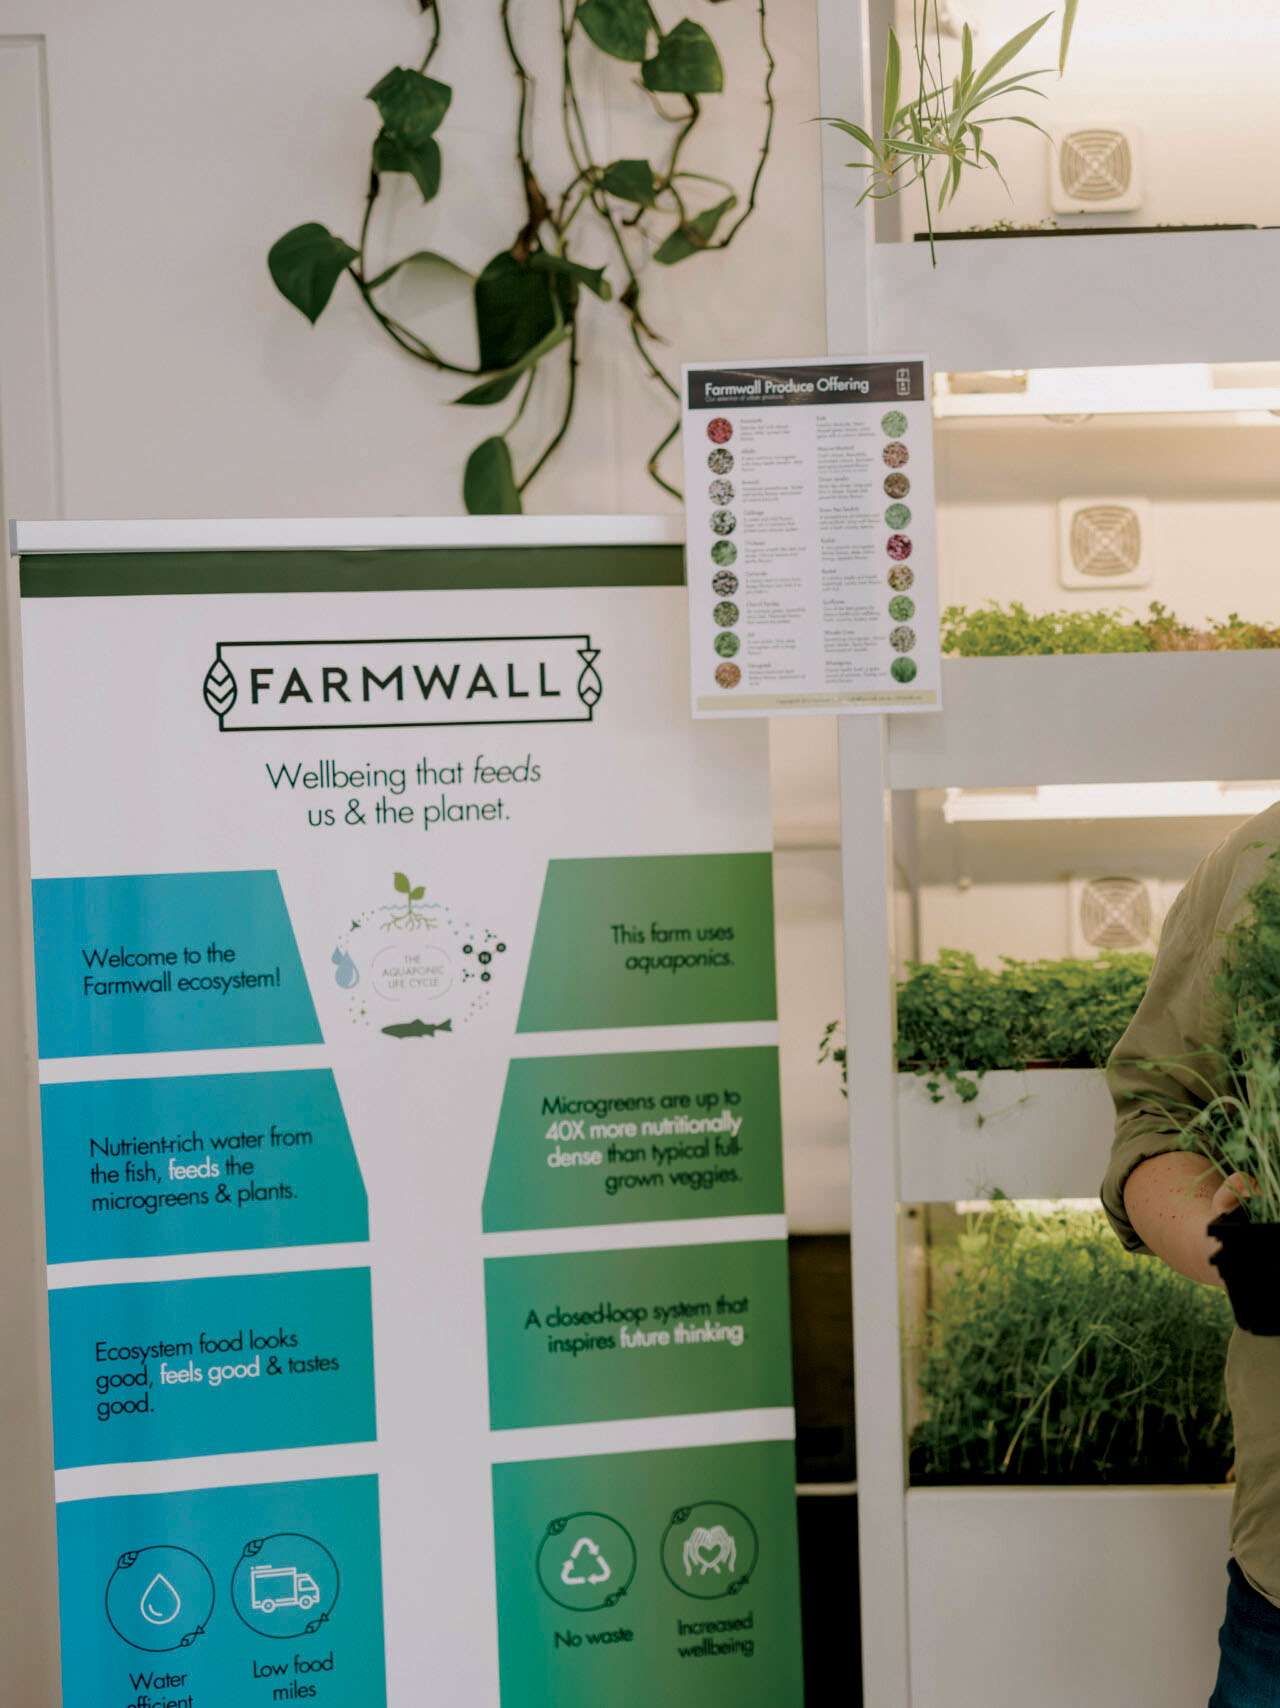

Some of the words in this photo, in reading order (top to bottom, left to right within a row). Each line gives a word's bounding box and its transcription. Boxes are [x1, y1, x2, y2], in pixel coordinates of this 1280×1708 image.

[704, 380, 761, 396] Farmwall
[764, 379, 814, 394] Produce
[816, 376, 870, 394] Offering
[249, 661, 562, 705] FARMWALL
[265, 759, 407, 795] Wellbeing
[416, 756, 465, 786] that
[473, 753, 543, 784] feeds
[307, 808, 336, 827] us
[344, 798, 367, 825] &
[375, 795, 414, 824] the
[423, 794, 512, 832] planet.
[610, 923, 645, 945] This
[651, 921, 691, 944] farm
[697, 926, 735, 942] uses
[82, 945, 178, 969] Welcome
[184, 947, 201, 964] to
[207, 941, 236, 964] the
[625, 949, 736, 975] aquaponics.
[83, 971, 172, 996] Farmwall
[177, 966, 281, 996] ecosystem!
[541, 1095, 655, 1118] Microgreens
[660, 1094, 691, 1109] are
[696, 1091, 719, 1110] up
[724, 1089, 741, 1106] to
[545, 1119, 585, 1141] 40X
[589, 1123, 637, 1138] more
[641, 1109, 743, 1137] nutritionally
[89, 1131, 203, 1157] Nutrient-rich
[210, 1134, 264, 1149] water
[270, 1125, 312, 1146] from
[547, 1145, 602, 1168] dense
[607, 1143, 646, 1164] than
[651, 1139, 709, 1166] typical
[91, 1163, 119, 1184] the
[125, 1160, 162, 1183] fish,
[168, 1155, 220, 1180] feeds
[225, 1155, 254, 1175] the
[605, 1172, 664, 1195] grown
[670, 1165, 742, 1190] veggies.
[92, 1190, 209, 1214] microgreens
[215, 1183, 231, 1202] &
[237, 1181, 298, 1207] plants.
[524, 1309, 541, 1329] A
[653, 1302, 711, 1325] system
[716, 1295, 748, 1314] that
[96, 1340, 193, 1365] Ecosystem
[199, 1330, 243, 1353] food
[249, 1328, 298, 1349] looks
[547, 1332, 616, 1357] inspires
[620, 1325, 669, 1348] future
[96, 1366, 153, 1394] good,
[160, 1360, 202, 1385] feels
[208, 1354, 260, 1386] good
[266, 1356, 282, 1375] &
[288, 1355, 340, 1374] tastes
[96, 1392, 154, 1421] good.
[677, 1610, 754, 1635] Increased
[554, 1630, 582, 1648] No
[586, 1627, 634, 1644] waste
[678, 1638, 754, 1658] wellbeing
[253, 1660, 288, 1679] Low
[293, 1651, 334, 1674] food
[129, 1672, 188, 1691] Water
[272, 1680, 317, 1701] miles
